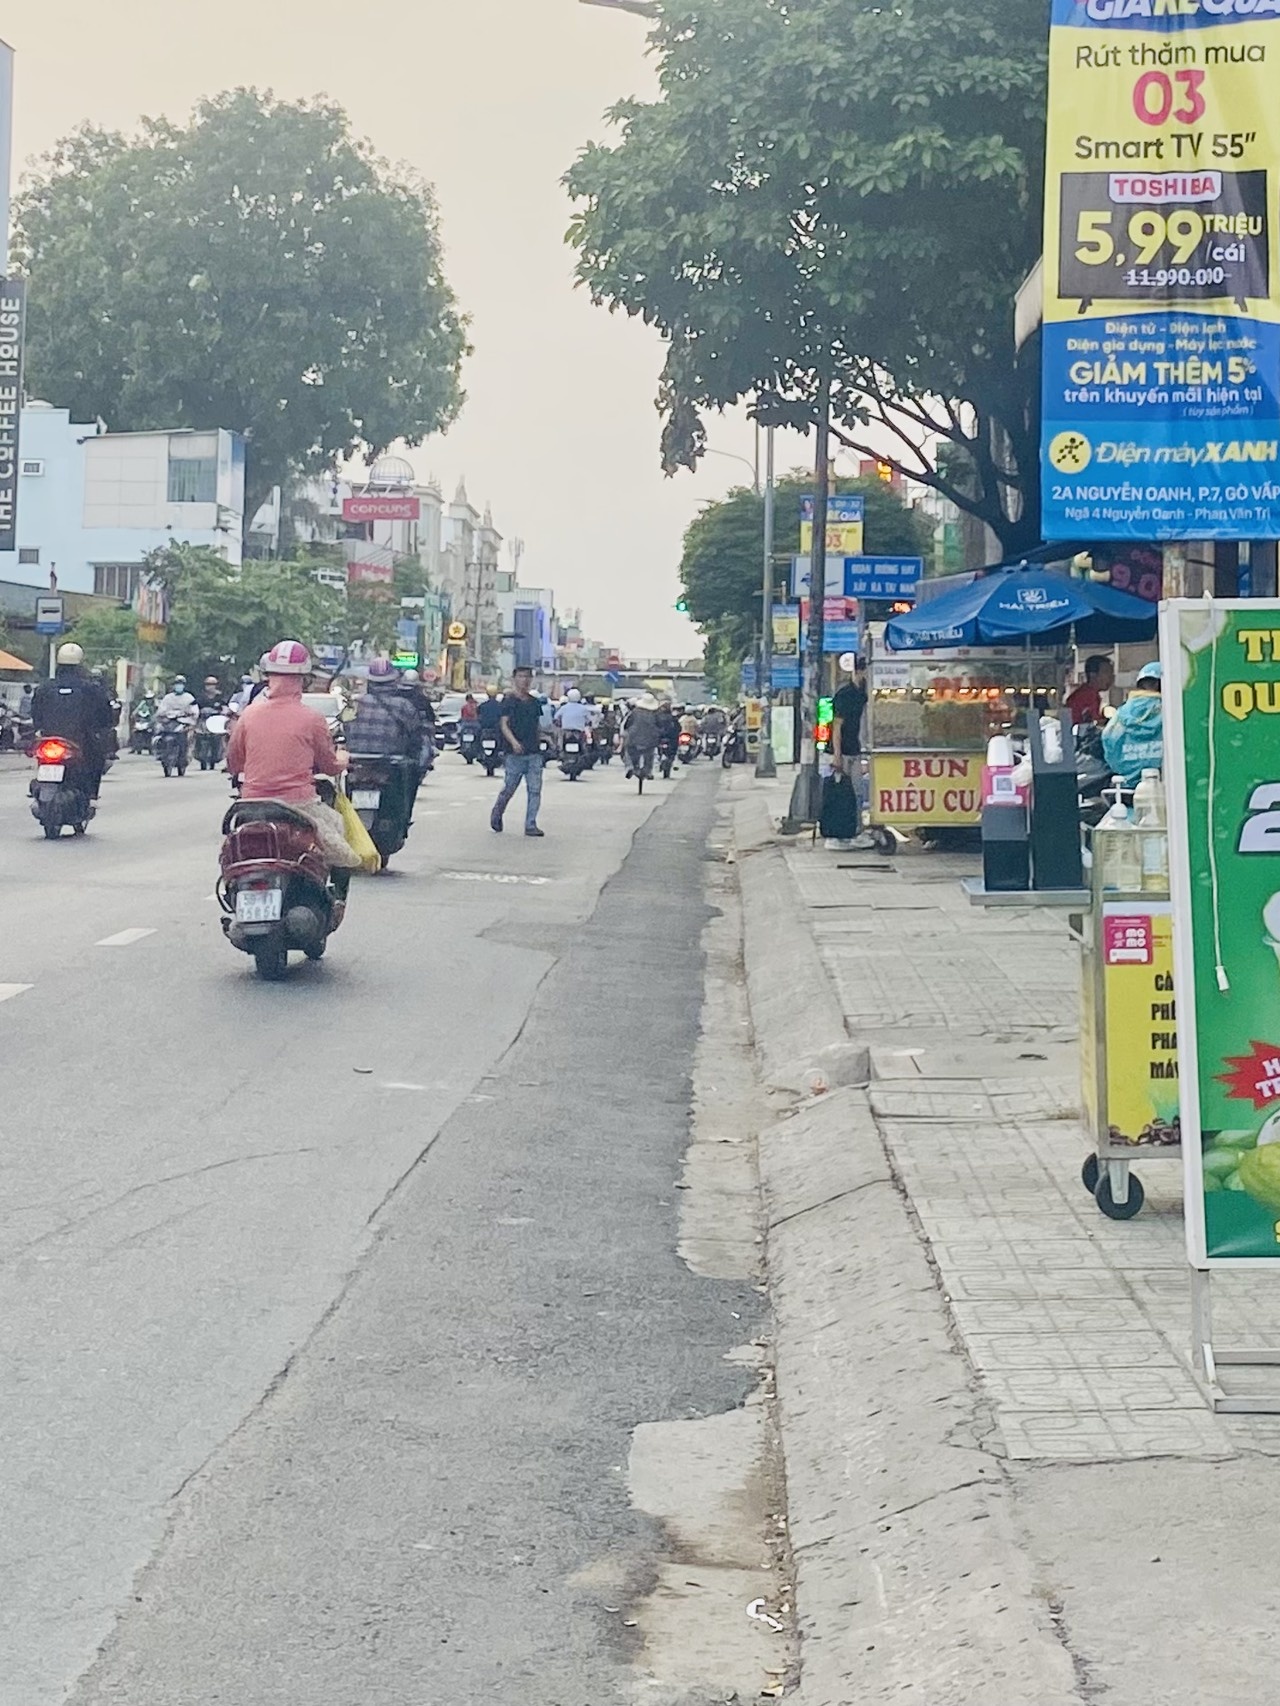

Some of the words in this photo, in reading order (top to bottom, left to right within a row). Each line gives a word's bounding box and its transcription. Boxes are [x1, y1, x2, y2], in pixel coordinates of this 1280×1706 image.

[1076, 45, 1121, 68] Rút
[1128, 41, 1196, 66] thăm
[1203, 44, 1266, 64] mua
[1132, 69, 1206, 126] 03
[1075, 135, 1164, 160] Smart
[1171, 133, 1203, 157] TV
[1114, 177, 1216, 197] TOSHIBA
[1074, 210, 1204, 267] 5,99
[1203, 212, 1263, 242] TRIỆU
[2, 297, 20, 376] HOUSE
[1102, 340, 1125, 354] gia
[1128, 338, 1166, 355] dụng
[1069, 354, 1147, 386] GIẢM
[1152, 354, 1223, 386] THÊM
[1227, 356, 1257, 384] 5%
[1064, 387, 1100, 403] trên
[1104, 386, 1169, 406] khuyến
[1172, 386, 1202, 403] mãi
[1206, 386, 1240, 406] hiện
[1243, 386, 1262, 405] tại
[0, 386, 17, 479] COFFEE
[1096, 440, 1150, 468] Điện
[1153, 442, 1203, 467] máy
[1204, 440, 1278, 463] XANH
[1052, 485, 1073, 500] 2A
[1076, 481, 1143, 501] NGUYỄN
[1146, 486, 1195, 502] OANH,
[1199, 486, 1223, 503] P.7,
[1226, 483, 1249, 499] GÒ
[1153, 508, 1185, 520] Oanh
[903, 753, 970, 778] BÚN
[880, 782, 936, 813] RIÊU
